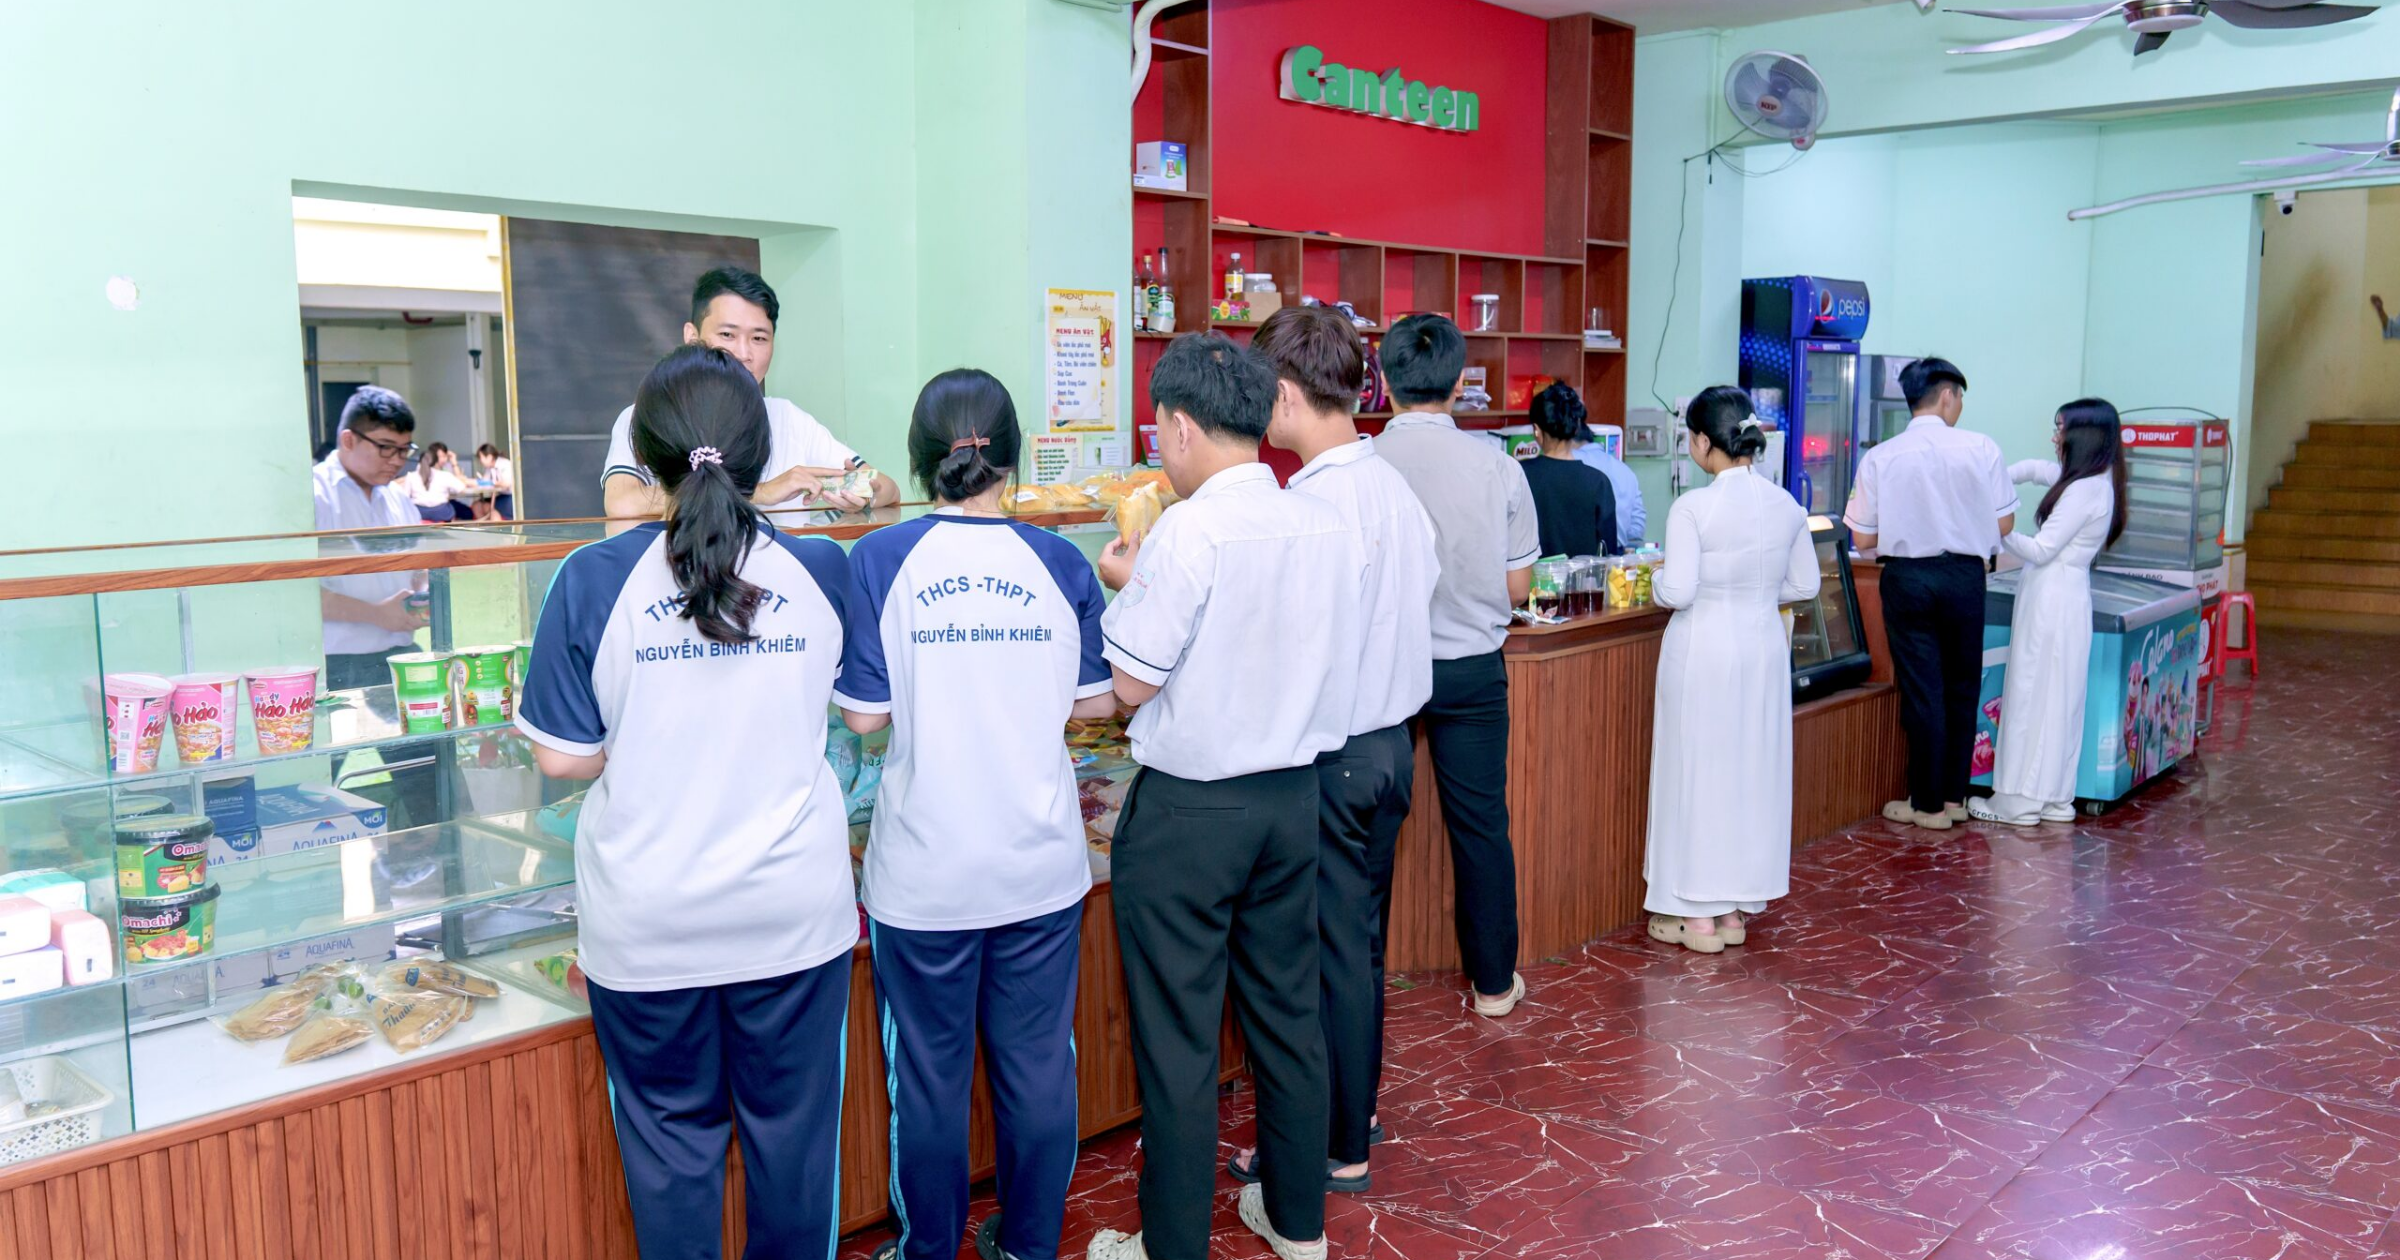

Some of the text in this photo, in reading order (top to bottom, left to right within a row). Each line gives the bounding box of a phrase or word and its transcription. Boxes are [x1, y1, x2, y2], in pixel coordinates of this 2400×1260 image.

[1291, 45, 1480, 131] Canteen
[1838, 296, 1865, 320] pepsi
[1516, 446, 1538, 456] MILO
[917, 576, 970, 607] THCS
[911, 623, 966, 643] NGUYỄN
[636, 638, 703, 663] NGUYỄN
[757, 635, 806, 653] KHIÊM
[184, 702, 219, 724] Hảo
[255, 700, 286, 718] Hảo
[1971, 809, 2000, 821] crocs
[122, 914, 172, 928] Omachi
[306, 938, 353, 955] AQUAFINA
